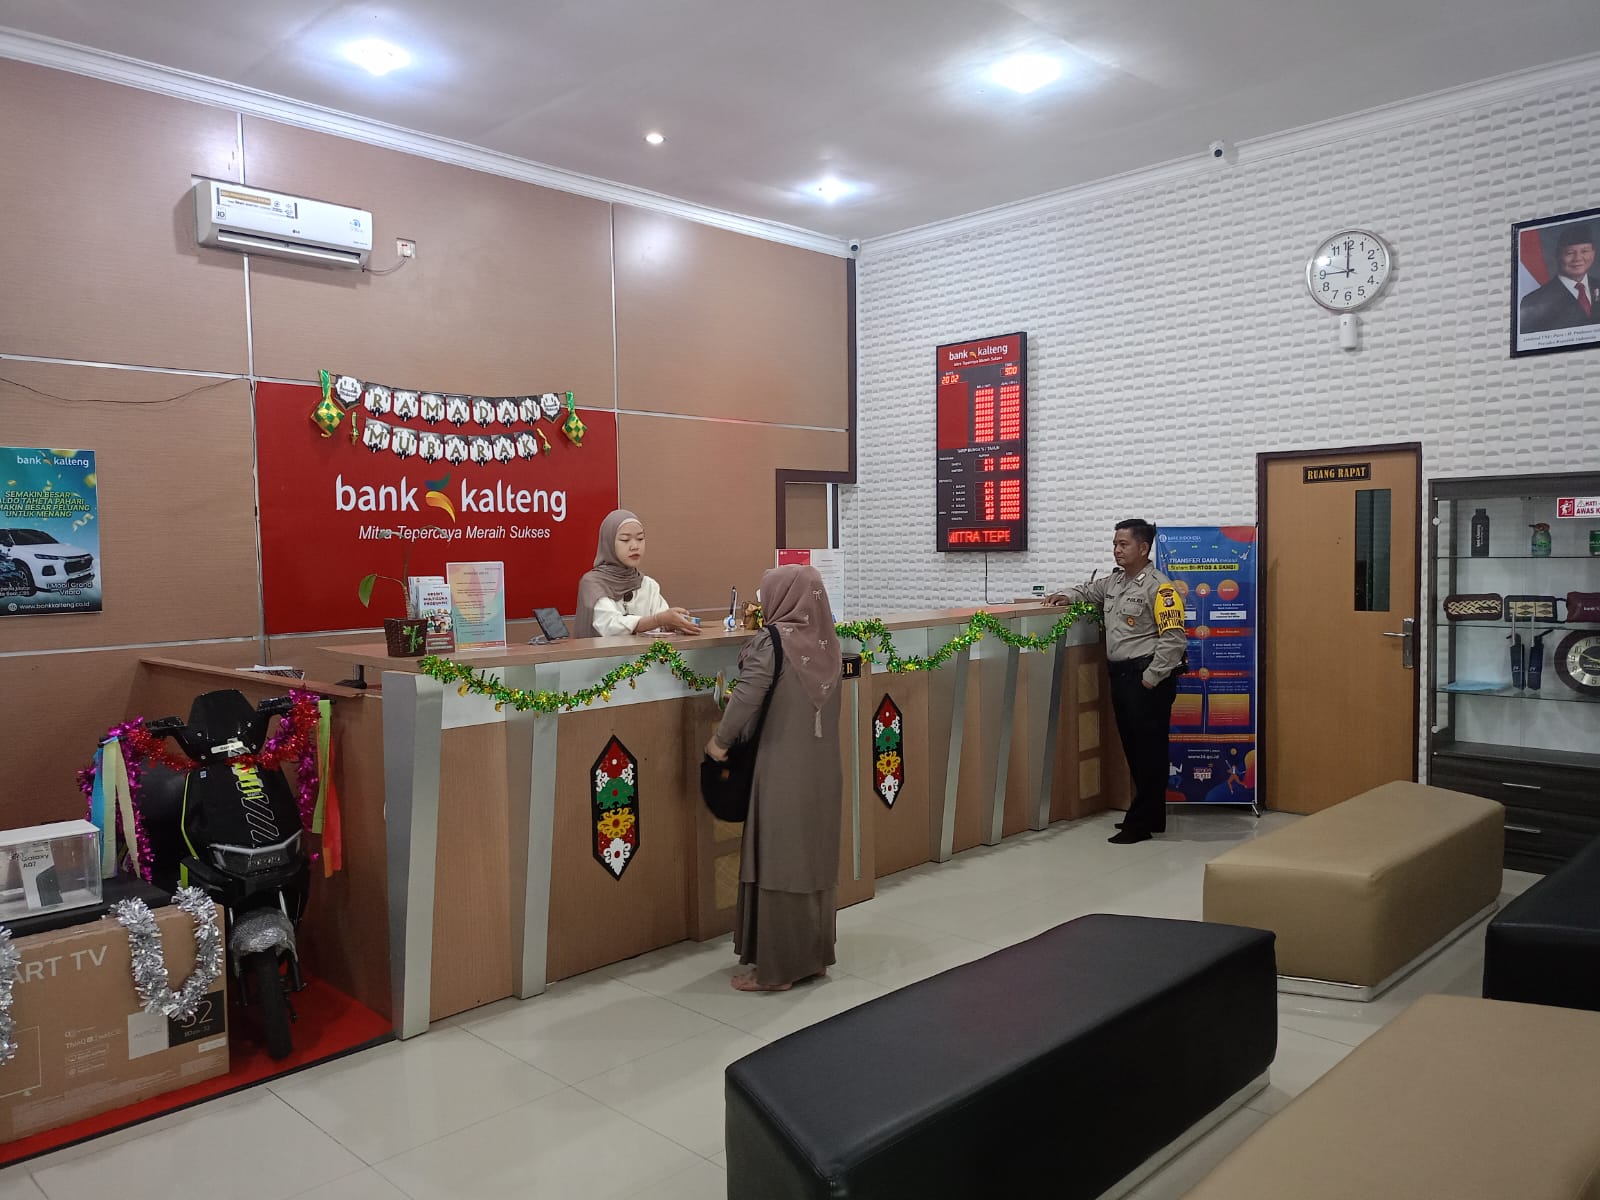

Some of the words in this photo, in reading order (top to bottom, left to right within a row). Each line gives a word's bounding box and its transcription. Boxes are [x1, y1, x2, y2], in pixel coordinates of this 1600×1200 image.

[1332, 245, 1340, 256] 11
[1343, 240, 1355, 251] 12
[1360, 241, 1364, 251] 1
[1367, 249, 1375, 260] 2
[1370, 261, 1378, 272] 3
[1319, 269, 1326, 279] 9
[1367, 275, 1375, 285] 4
[1322, 281, 1330, 292] 8
[1357, 285, 1365, 296] 5
[1332, 289, 1339, 300] 7
[1344, 291, 1352, 301] 6
[949, 349, 968, 360] bank
[977, 345, 1008, 357] kalteng
[372, 393, 537, 419] RAMADAN
[369, 430, 533, 457] MUBARAK
[17, 455, 42, 465] bank
[53, 456, 89, 468] kalteng
[1307, 469, 1335, 480] RUANG
[1338, 467, 1366, 478] RAPAT
[5, 490, 42, 498] SEMAKIN
[335, 473, 419, 512] bank
[461, 477, 567, 522] kalteng
[359, 525, 392, 540] Mitra
[397, 525, 462, 542] Tepercaya
[465, 525, 506, 539] Meraih
[509, 525, 551, 539] Sukses
[69, 945, 108, 971] TV
